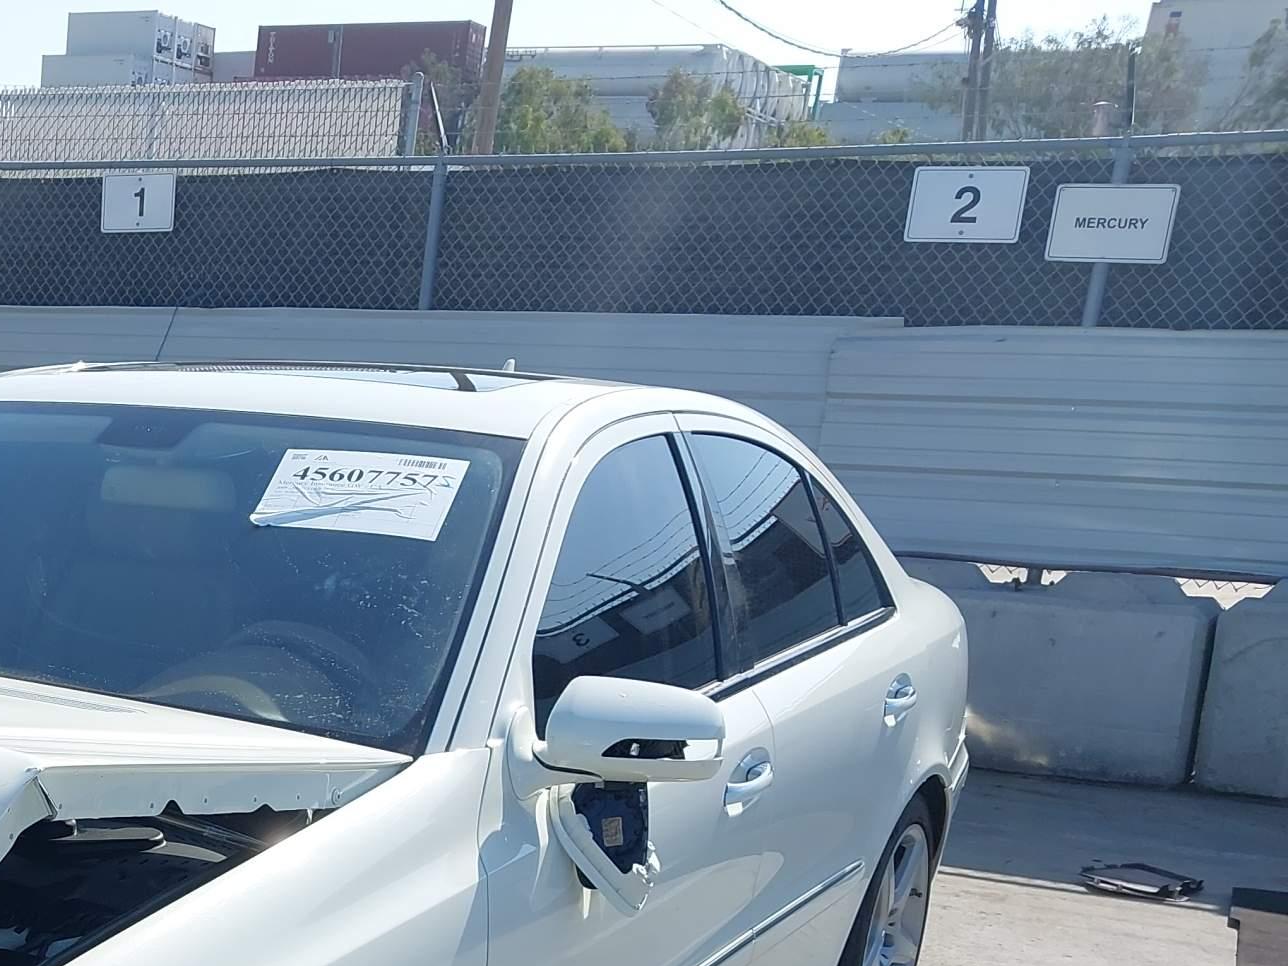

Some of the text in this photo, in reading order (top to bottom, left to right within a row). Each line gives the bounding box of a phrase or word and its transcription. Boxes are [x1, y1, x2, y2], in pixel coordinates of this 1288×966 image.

[134, 187, 145, 217] 1
[950, 185, 982, 224] 2
[1074, 217, 1149, 230] MERCURY
